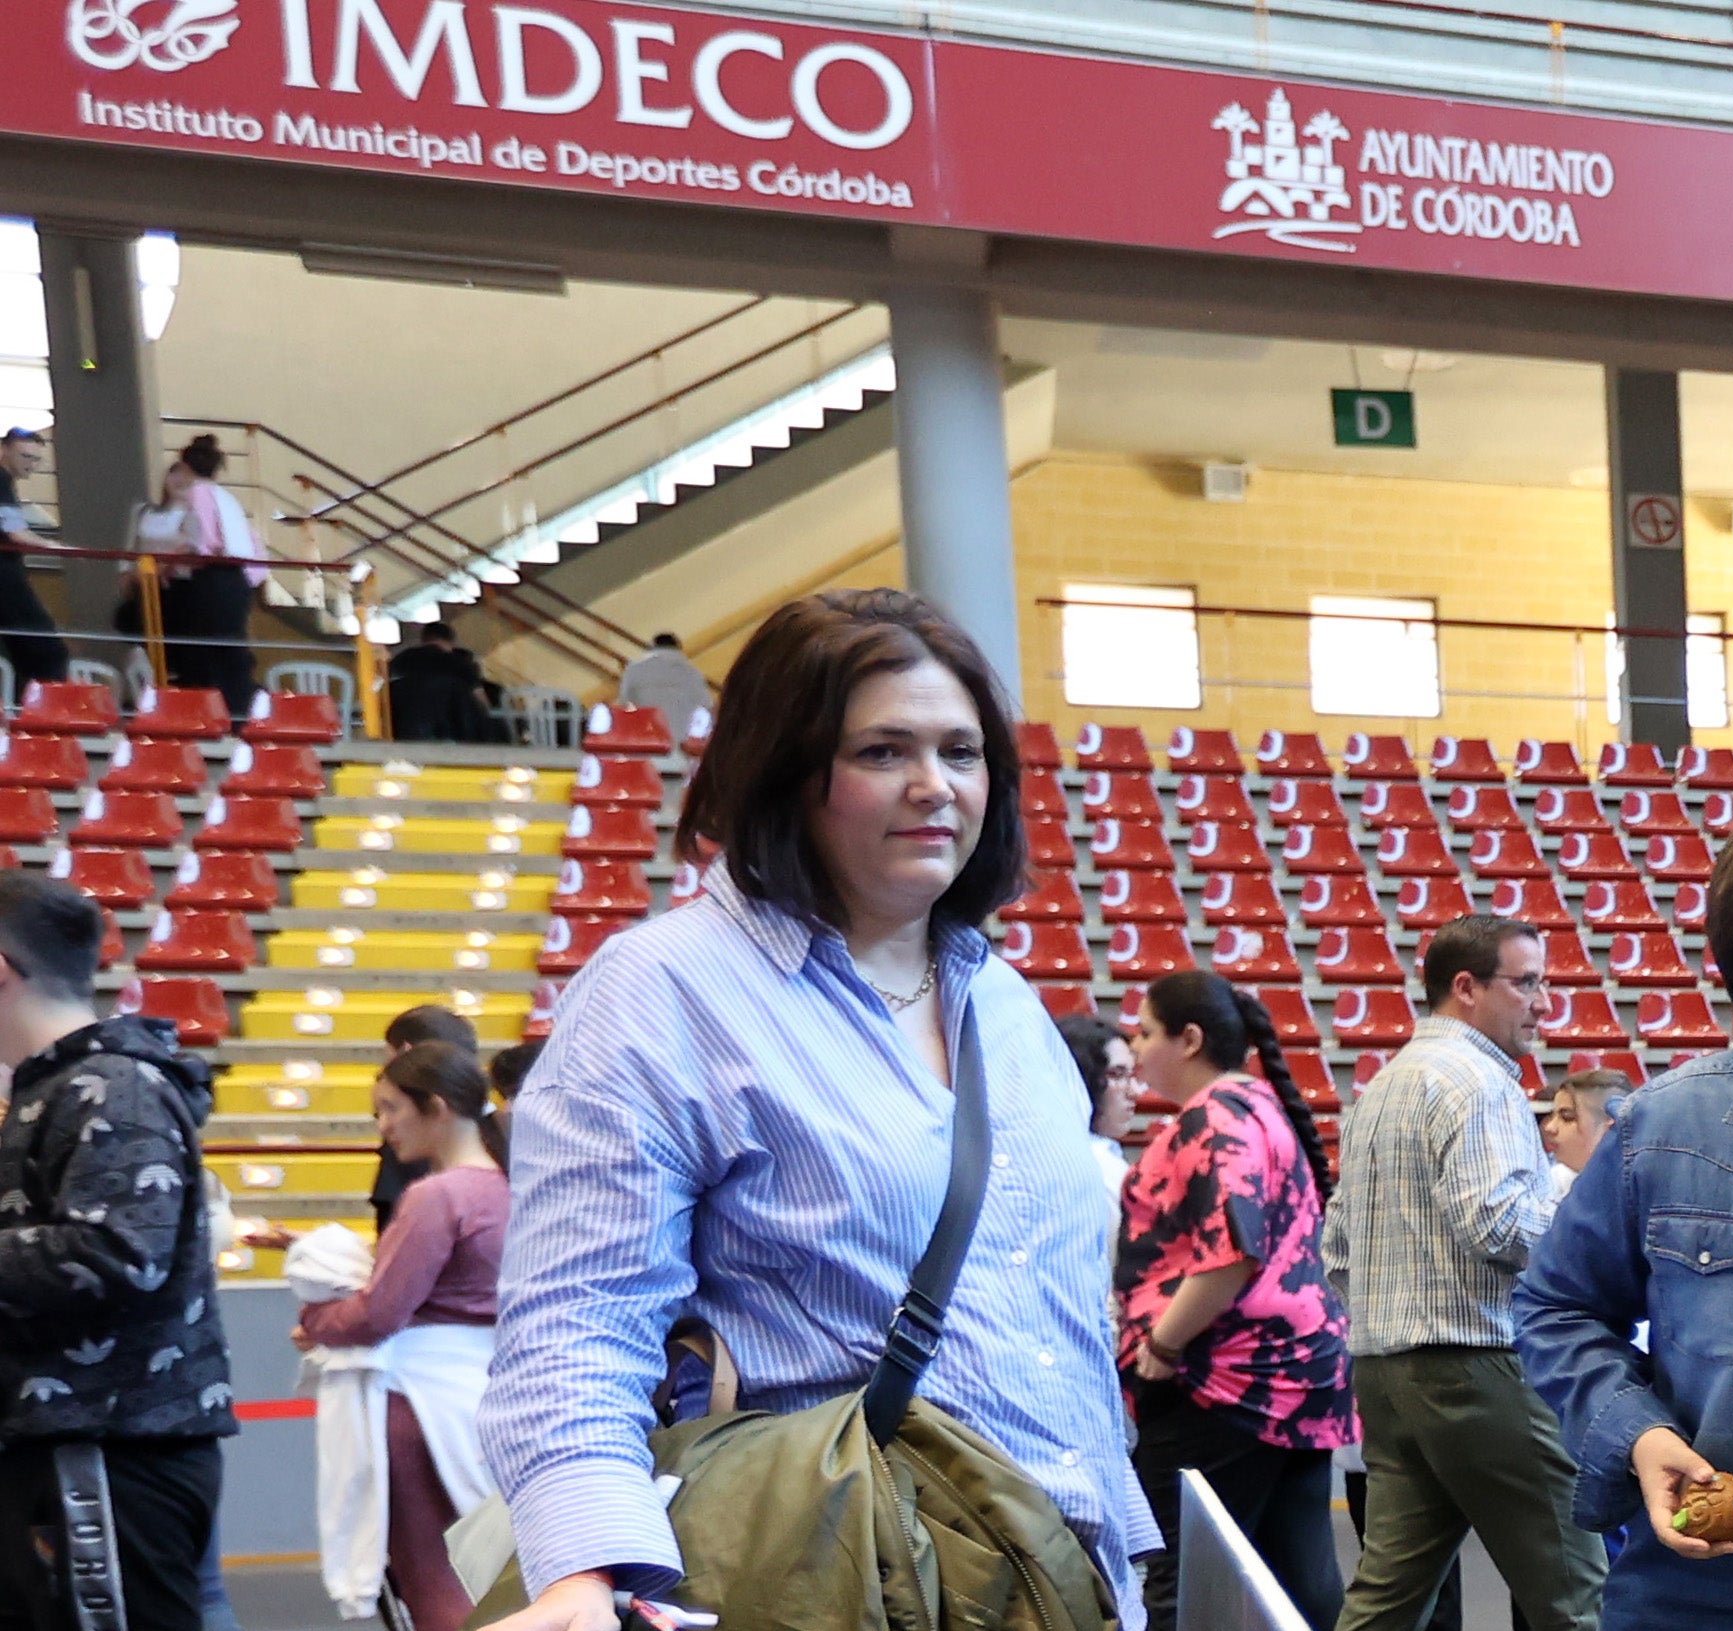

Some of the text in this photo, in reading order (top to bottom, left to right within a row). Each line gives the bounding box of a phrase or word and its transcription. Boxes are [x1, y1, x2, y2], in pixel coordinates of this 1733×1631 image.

[282, 0, 914, 151] IMDECO
[78, 91, 915, 208] Instituto Municipal de Deportes Córdoba
[1358, 127, 1615, 199] AYUNTAMIENTO
[1360, 182, 1581, 248] DE CÓRDOBA
[1355, 397, 1392, 440] D
